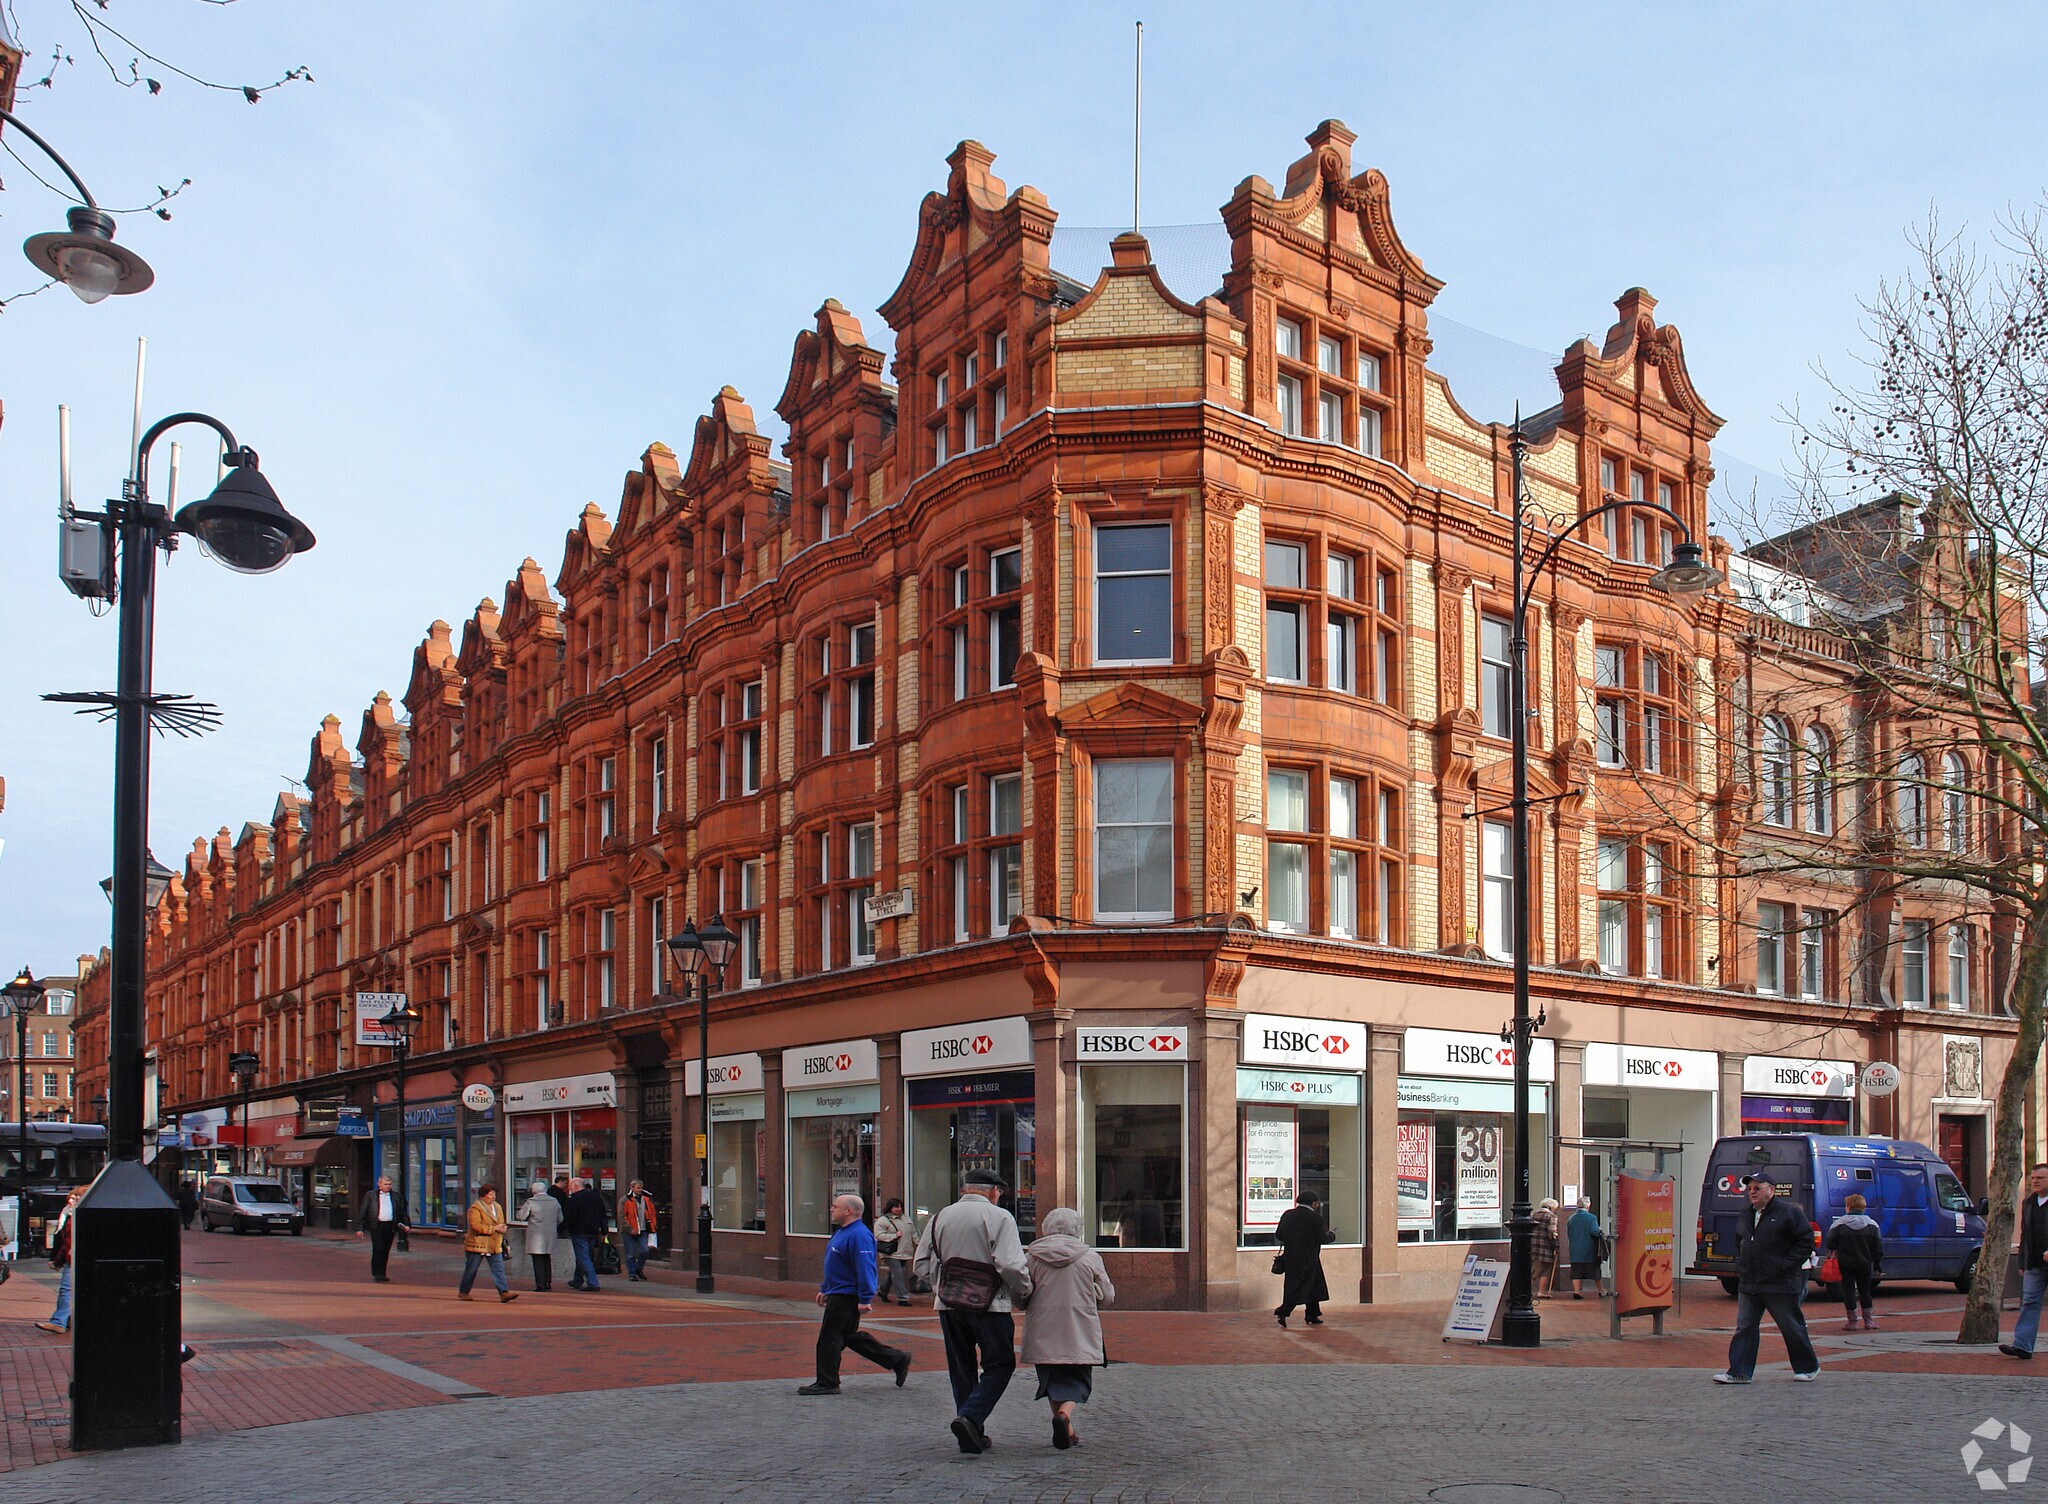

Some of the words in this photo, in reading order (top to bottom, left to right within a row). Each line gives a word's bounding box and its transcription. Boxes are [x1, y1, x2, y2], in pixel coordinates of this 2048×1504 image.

[876, 904, 897, 916] STREET
[931, 1038, 970, 1060] HSBC
[1082, 1036, 1145, 1052] HSBC
[1263, 1030, 1319, 1053] HSBC
[1447, 1045, 1492, 1065] HSBC
[803, 1056, 834, 1075] HSBC
[1627, 1059, 1662, 1076] HSBC
[1775, 1069, 1810, 1085] HSBC
[1865, 1078, 1894, 1087] HSBC
[542, 1088, 558, 1101] HSBC
[948, 1086, 963, 1095] HSBC
[973, 1083, 1000, 1093] PREMIER
[1261, 1080, 1288, 1092] HSBC
[1307, 1083, 1333, 1094] PLUS
[467, 1095, 493, 1104] HSBC
[1770, 1105, 1785, 1113] HSBC
[404, 1108, 436, 1127] SKIPTON
[1258, 1129, 1263, 1137] 6
[1409, 1122, 1426, 1140] OUR
[833, 1129, 858, 1164] 30
[1418, 1140, 1427, 1152] TO
[1460, 1126, 1498, 1163] 30
[834, 1165, 858, 1178] million
[1405, 1167, 1427, 1178] BUSINESS
[1461, 1166, 1497, 1178] million
[1718, 1175, 1747, 1194] G4S
